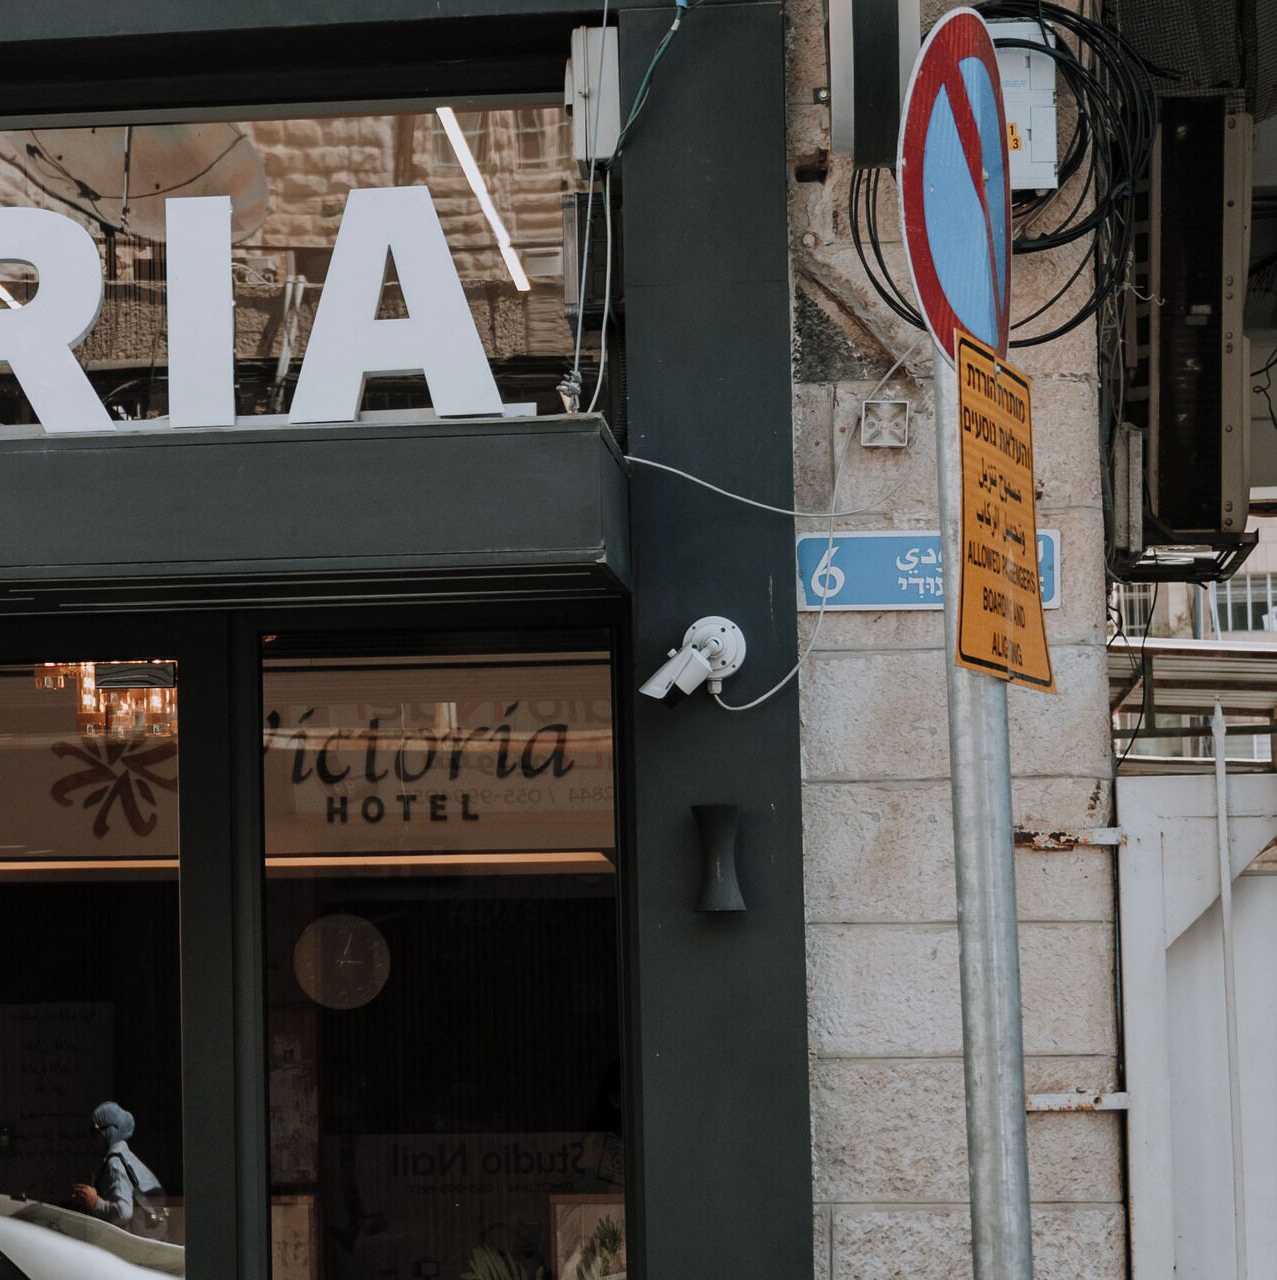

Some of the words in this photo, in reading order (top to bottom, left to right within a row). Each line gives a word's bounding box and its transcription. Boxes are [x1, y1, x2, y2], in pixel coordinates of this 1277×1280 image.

[963, 406, 996, 447] נוסעים
[999, 426, 1031, 470] והעלאת
[810, 545, 846, 600] 6
[967, 539, 1001, 574] ALLOWED
[1013, 602, 1026, 629] AND
[326, 794, 480, 824] HOTEL
